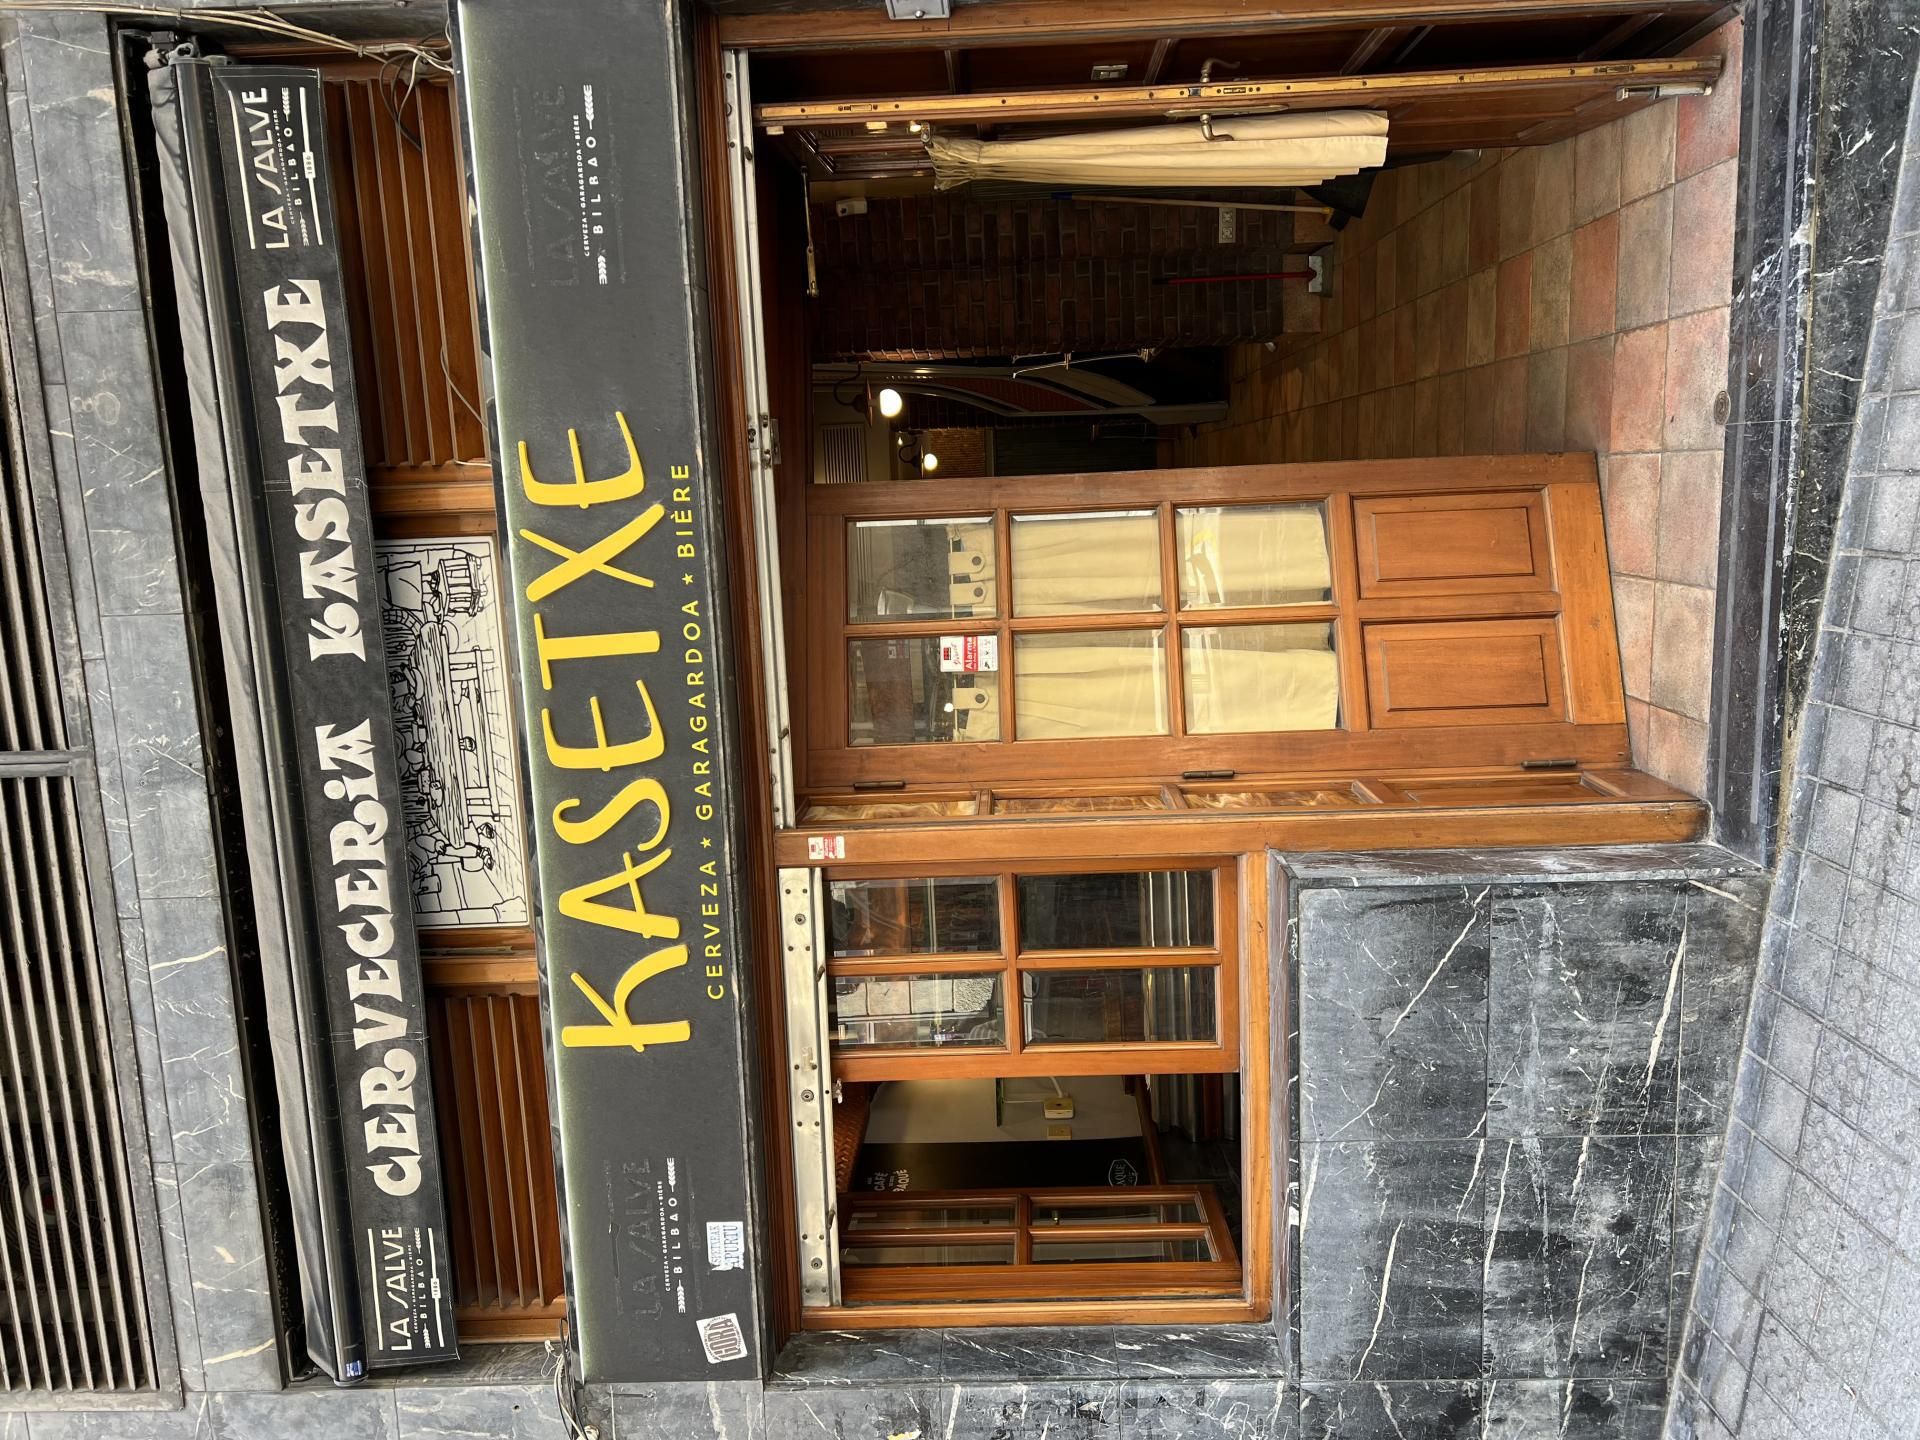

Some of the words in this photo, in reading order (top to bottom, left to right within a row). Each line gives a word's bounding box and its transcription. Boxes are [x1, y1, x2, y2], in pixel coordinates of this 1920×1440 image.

[242, 88, 281, 195] SALVE
[284, 128, 302, 205] BILBAO
[576, 149, 586, 208] GARAGARDOA
[585, 136, 604, 234] BILBAO
[261, 206, 289, 248] LA
[581, 218, 590, 256] CERVEZA
[264, 279, 366, 662] KASETXE
[670, 465, 695, 558] BIÈRE
[518, 411, 690, 1052] KASETXE
[682, 600, 712, 820] GARAGARDOA
[700, 861, 724, 1000] CERVEZA
[382, 1227, 408, 1309] SALVE
[659, 1207, 668, 1253] GARAGARDOA
[668, 1198, 682, 1273] BILBAO
[710, 1225, 721, 1264] SPETXEAK
[416, 1258, 427, 1319] BILBAO
[390, 1318, 412, 1350] LA
[708, 1319, 741, 1358] GORA
